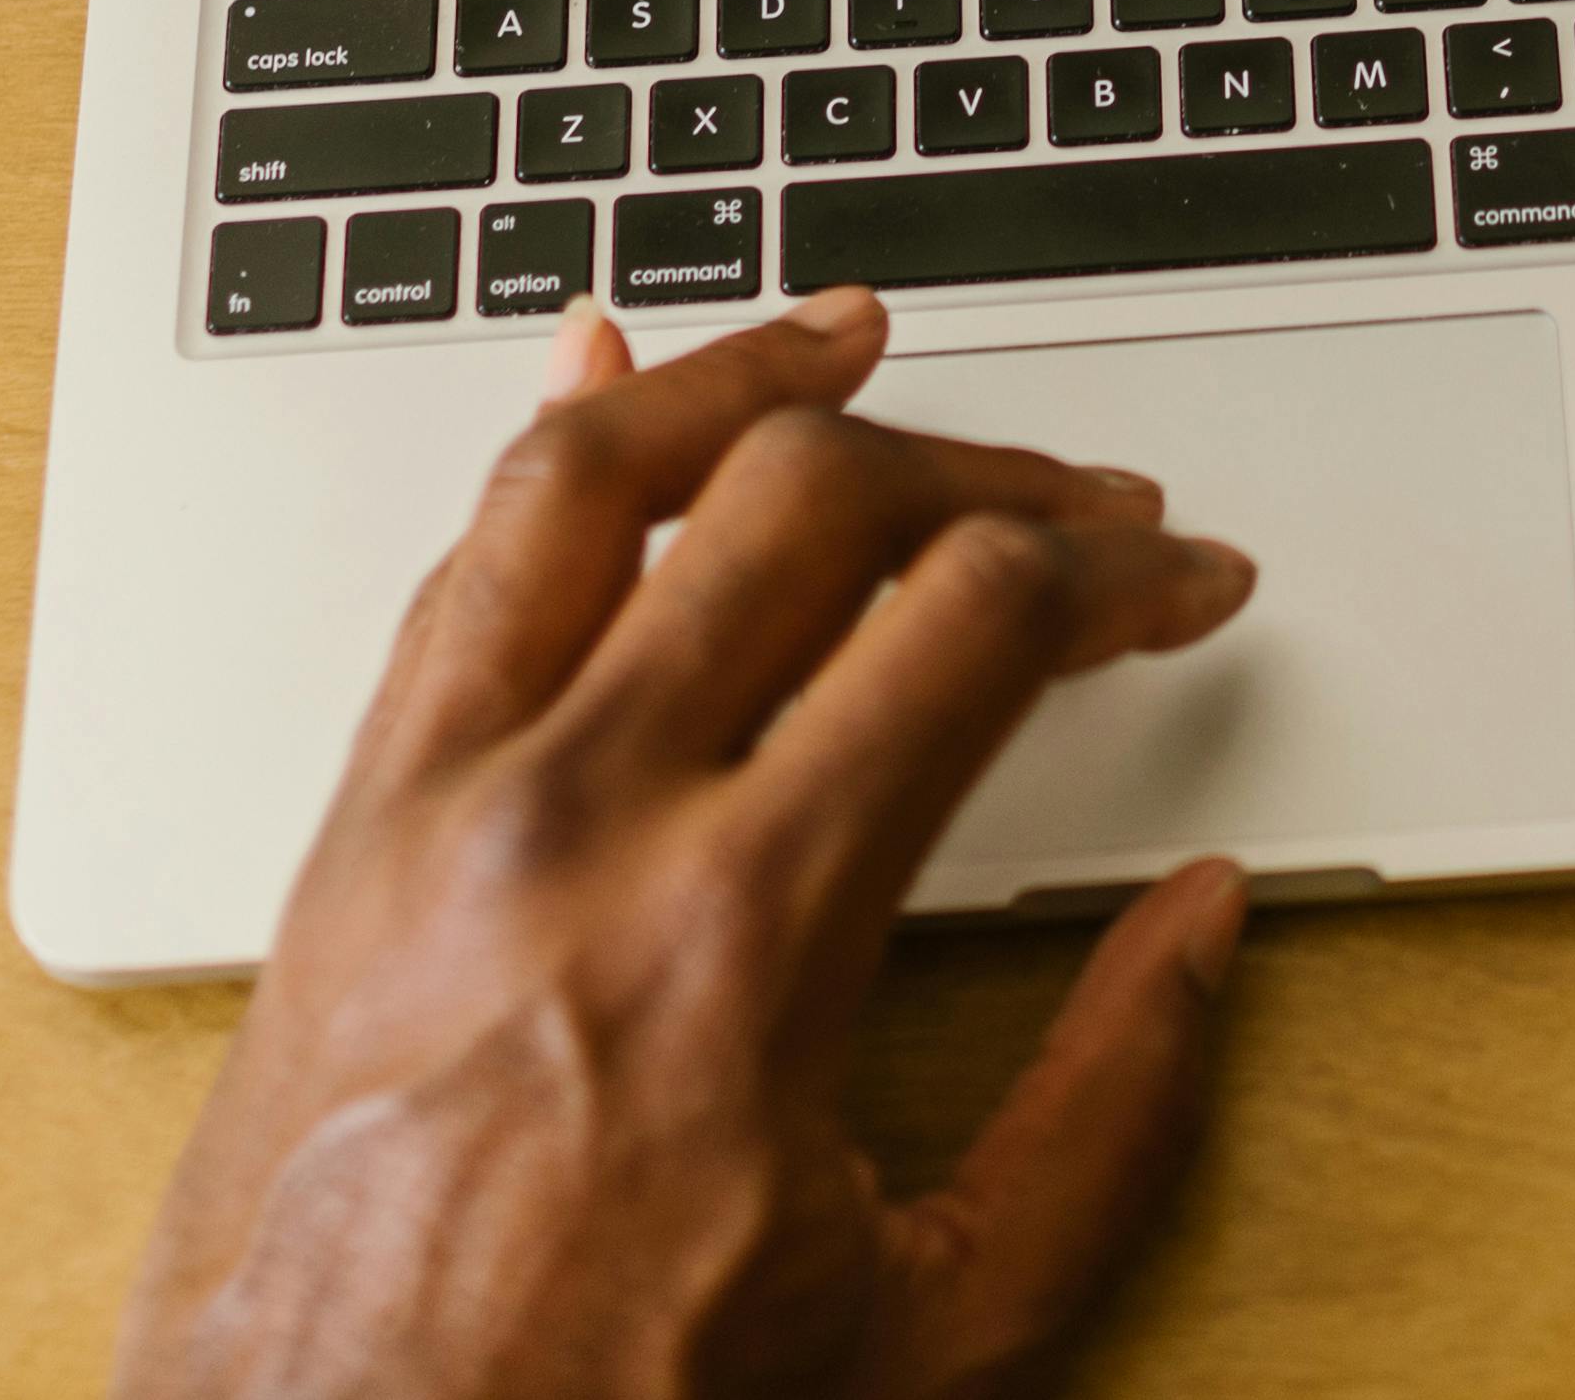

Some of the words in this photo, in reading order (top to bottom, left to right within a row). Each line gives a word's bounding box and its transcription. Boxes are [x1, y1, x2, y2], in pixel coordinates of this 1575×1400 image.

[497, 9, 523, 38] A
[631, 0, 652, 29] S
[247, 52, 299, 73] caps
[305, 45, 348, 67] lock
[1224, 69, 1250, 100] N
[1353, 60, 1387, 90] M
[958, 87, 983, 117] V
[1094, 79, 1116, 108] B
[692, 106, 718, 136] X
[825, 97, 850, 125] C
[560, 114, 584, 144] Z
[238, 160, 287, 183] shift
[491, 214, 516, 232] alt
[489, 273, 561, 299] option
[629, 258, 742, 286] command
[228, 292, 251, 314] fn
[354, 279, 432, 305] control
